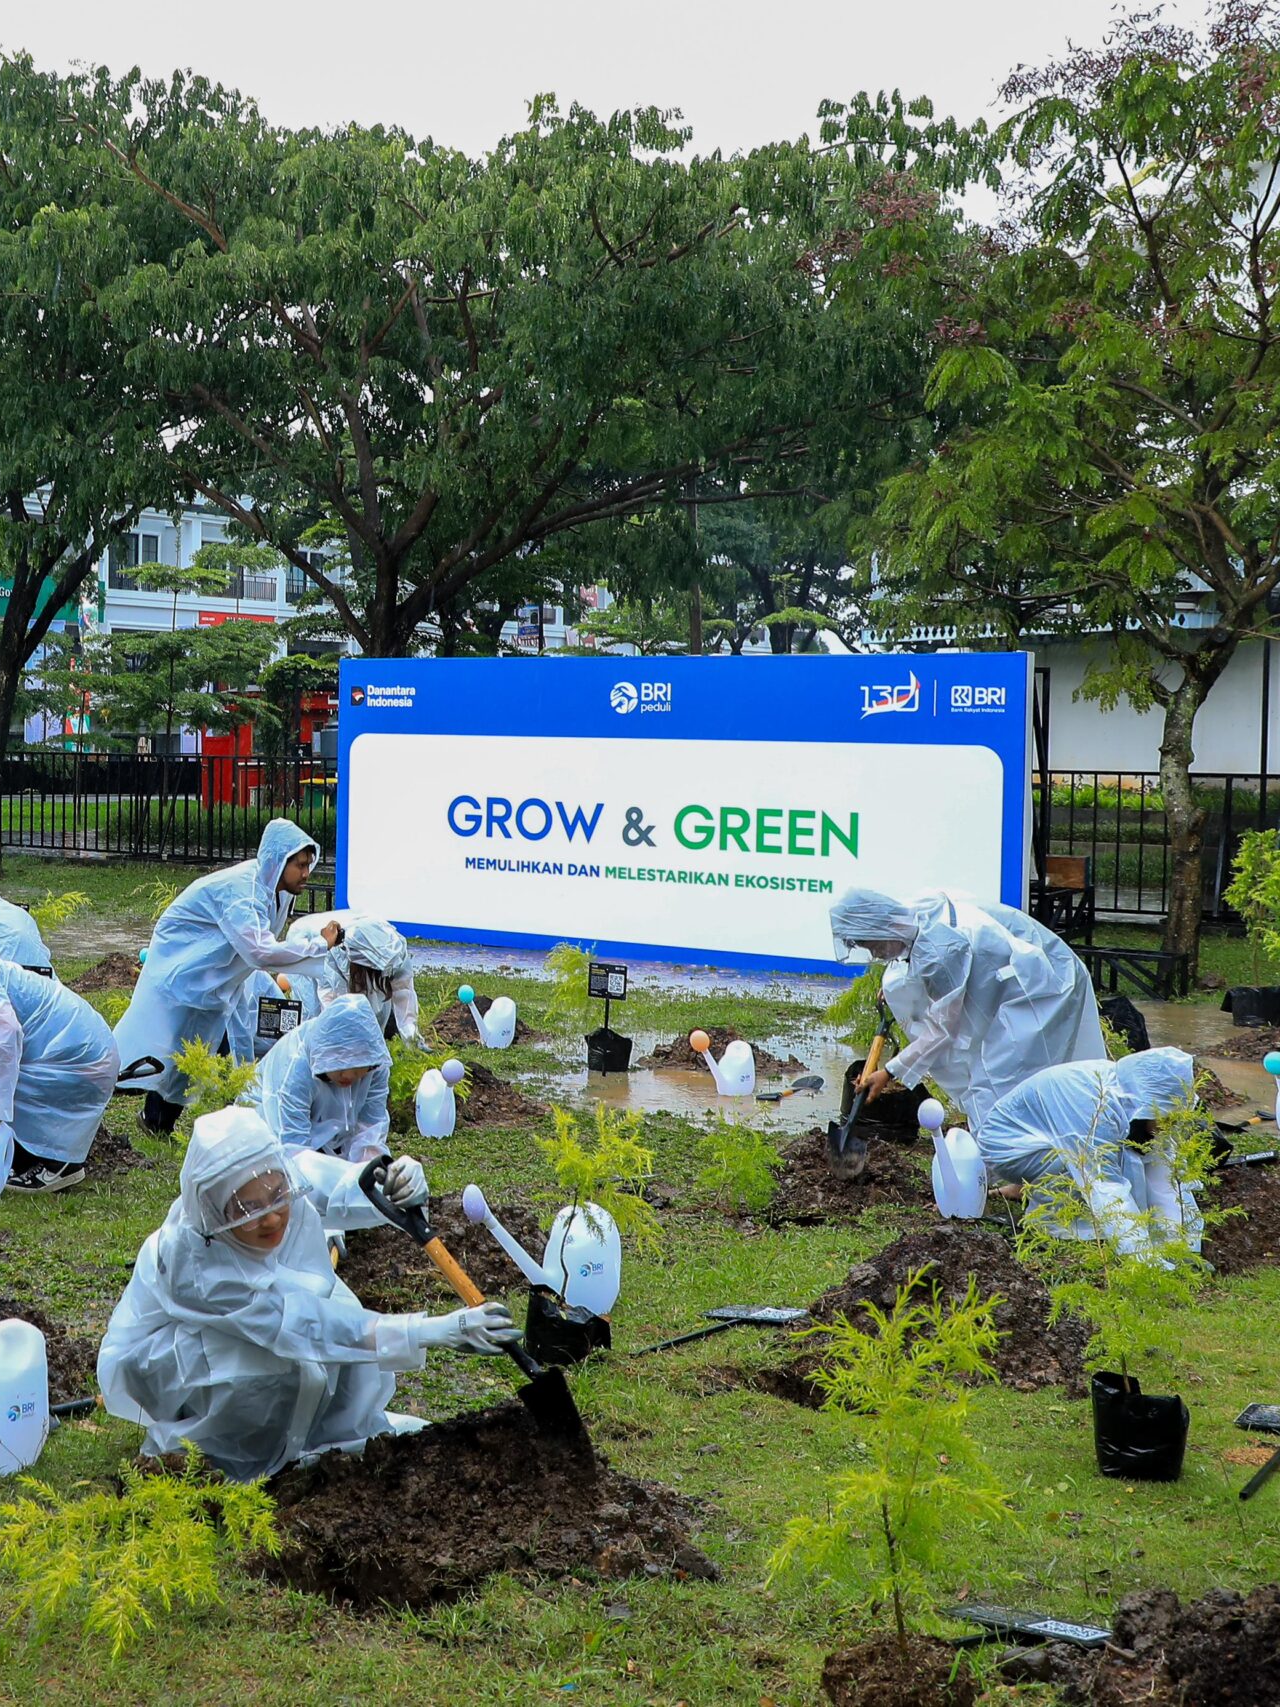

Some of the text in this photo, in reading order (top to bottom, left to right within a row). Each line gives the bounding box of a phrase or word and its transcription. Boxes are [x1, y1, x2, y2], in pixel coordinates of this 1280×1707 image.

[366, 685, 416, 697] Danantara
[640, 682, 672, 701] BRI
[974, 687, 1006, 705] BRI
[366, 696, 413, 708] Indonesia
[640, 702, 671, 714] peduli
[447, 794, 860, 860] GROW & GREEN
[465, 856, 833, 894] MEMULIHKAN DAN MELESTARIKAN EKOSISTEM
[592, 1263, 604, 1271] BRI
[22, 1401, 35, 1413] BRI
